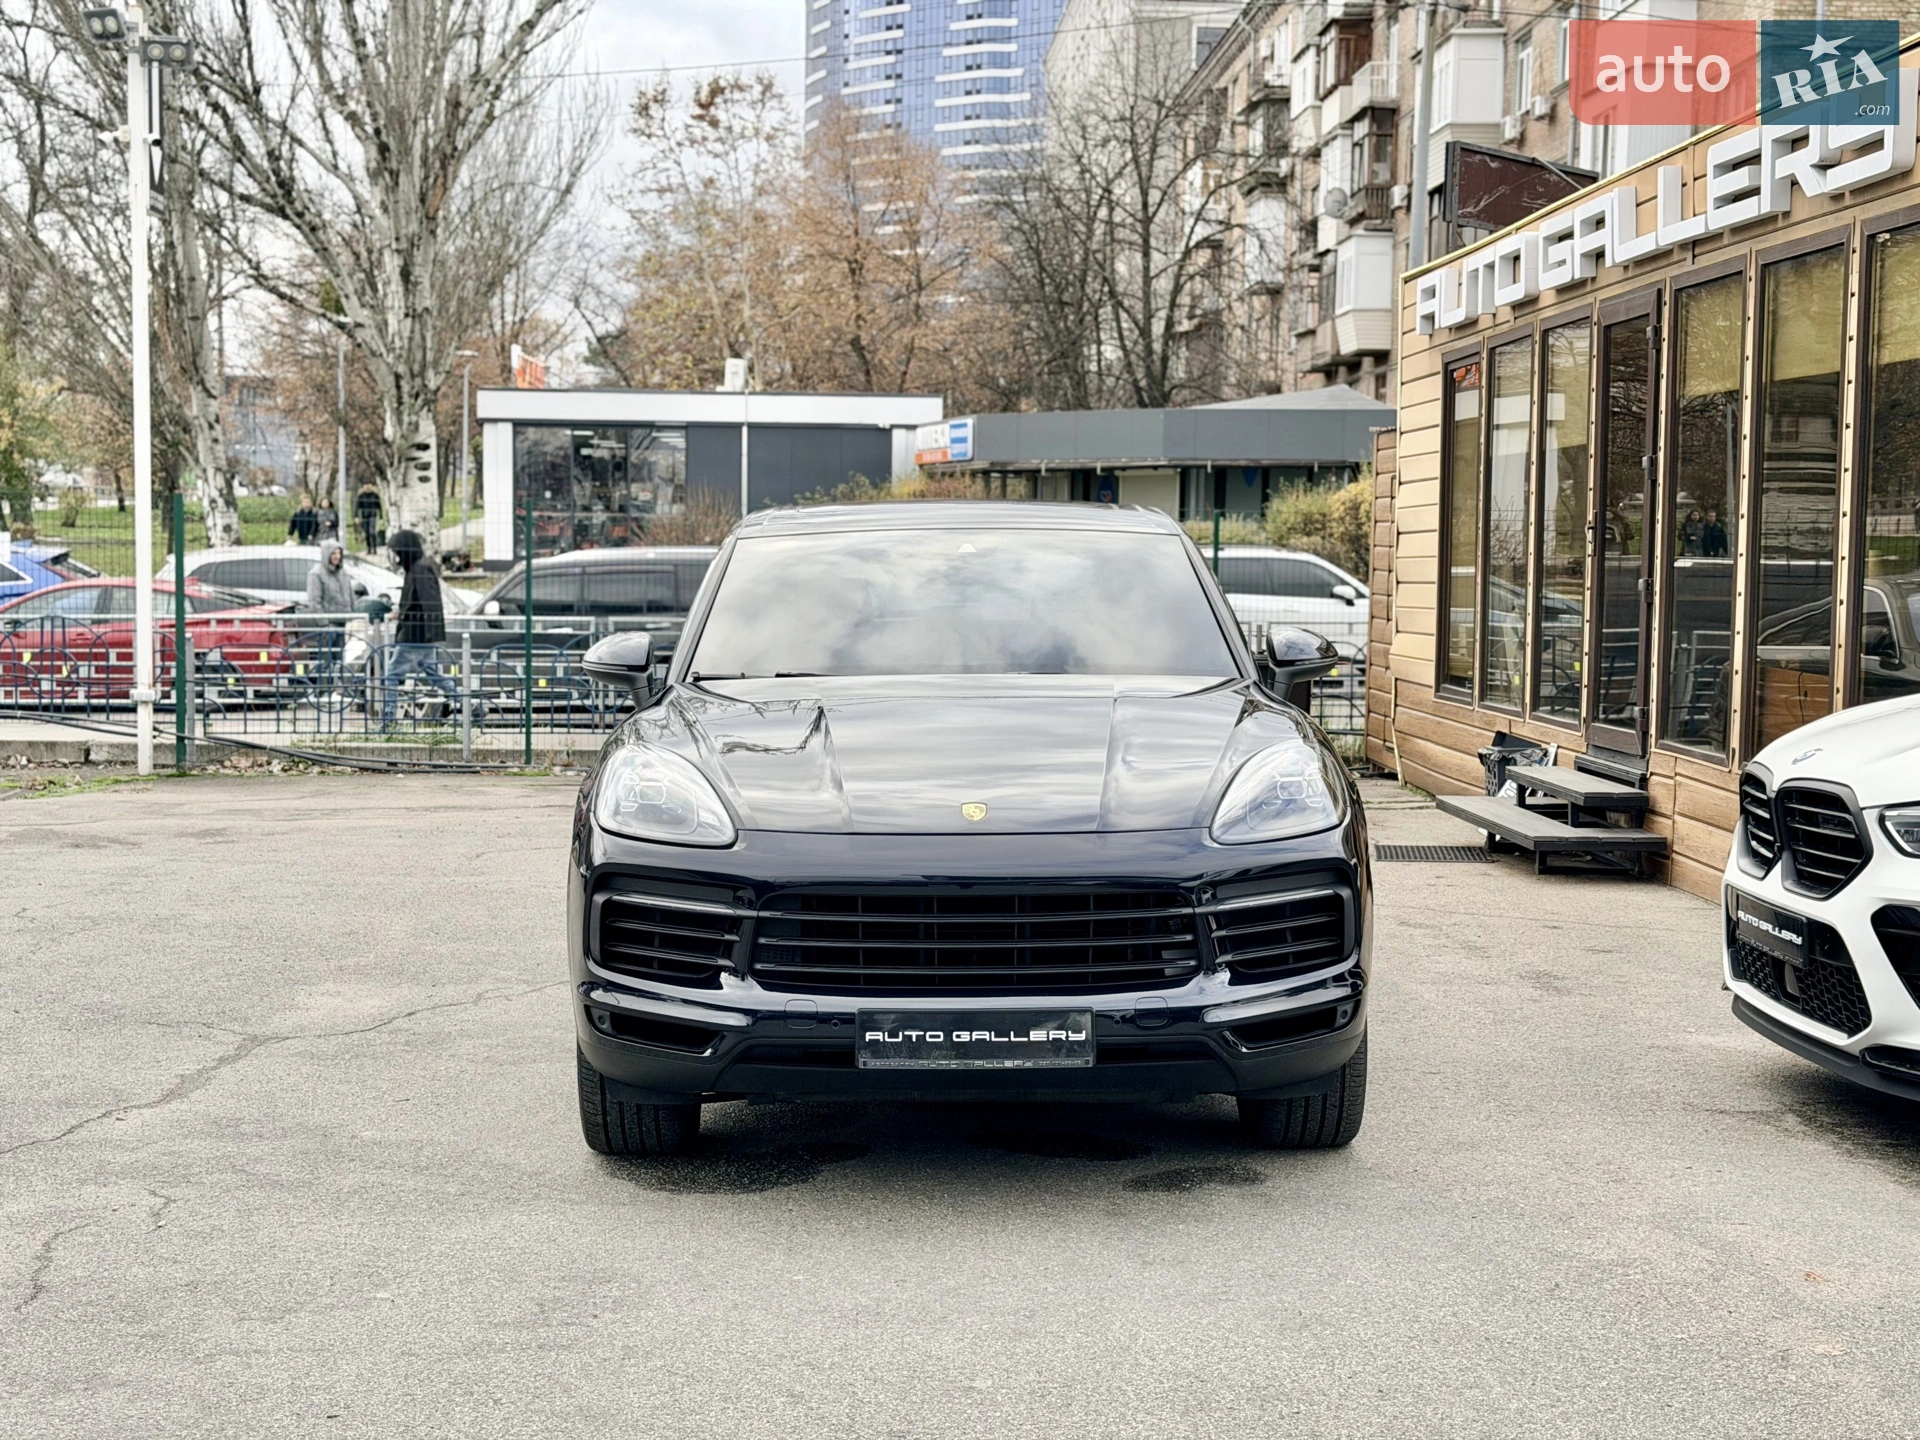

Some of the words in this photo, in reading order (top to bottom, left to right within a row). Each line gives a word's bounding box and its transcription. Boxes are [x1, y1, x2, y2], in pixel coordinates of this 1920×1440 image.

[1415, 231, 1539, 335] AUTO
[1737, 909, 1760, 928] AUTO
[1759, 919, 1803, 945] GALLERY
[865, 1031, 944, 1042] AUTO
[952, 1029, 1086, 1042] GALLERY
